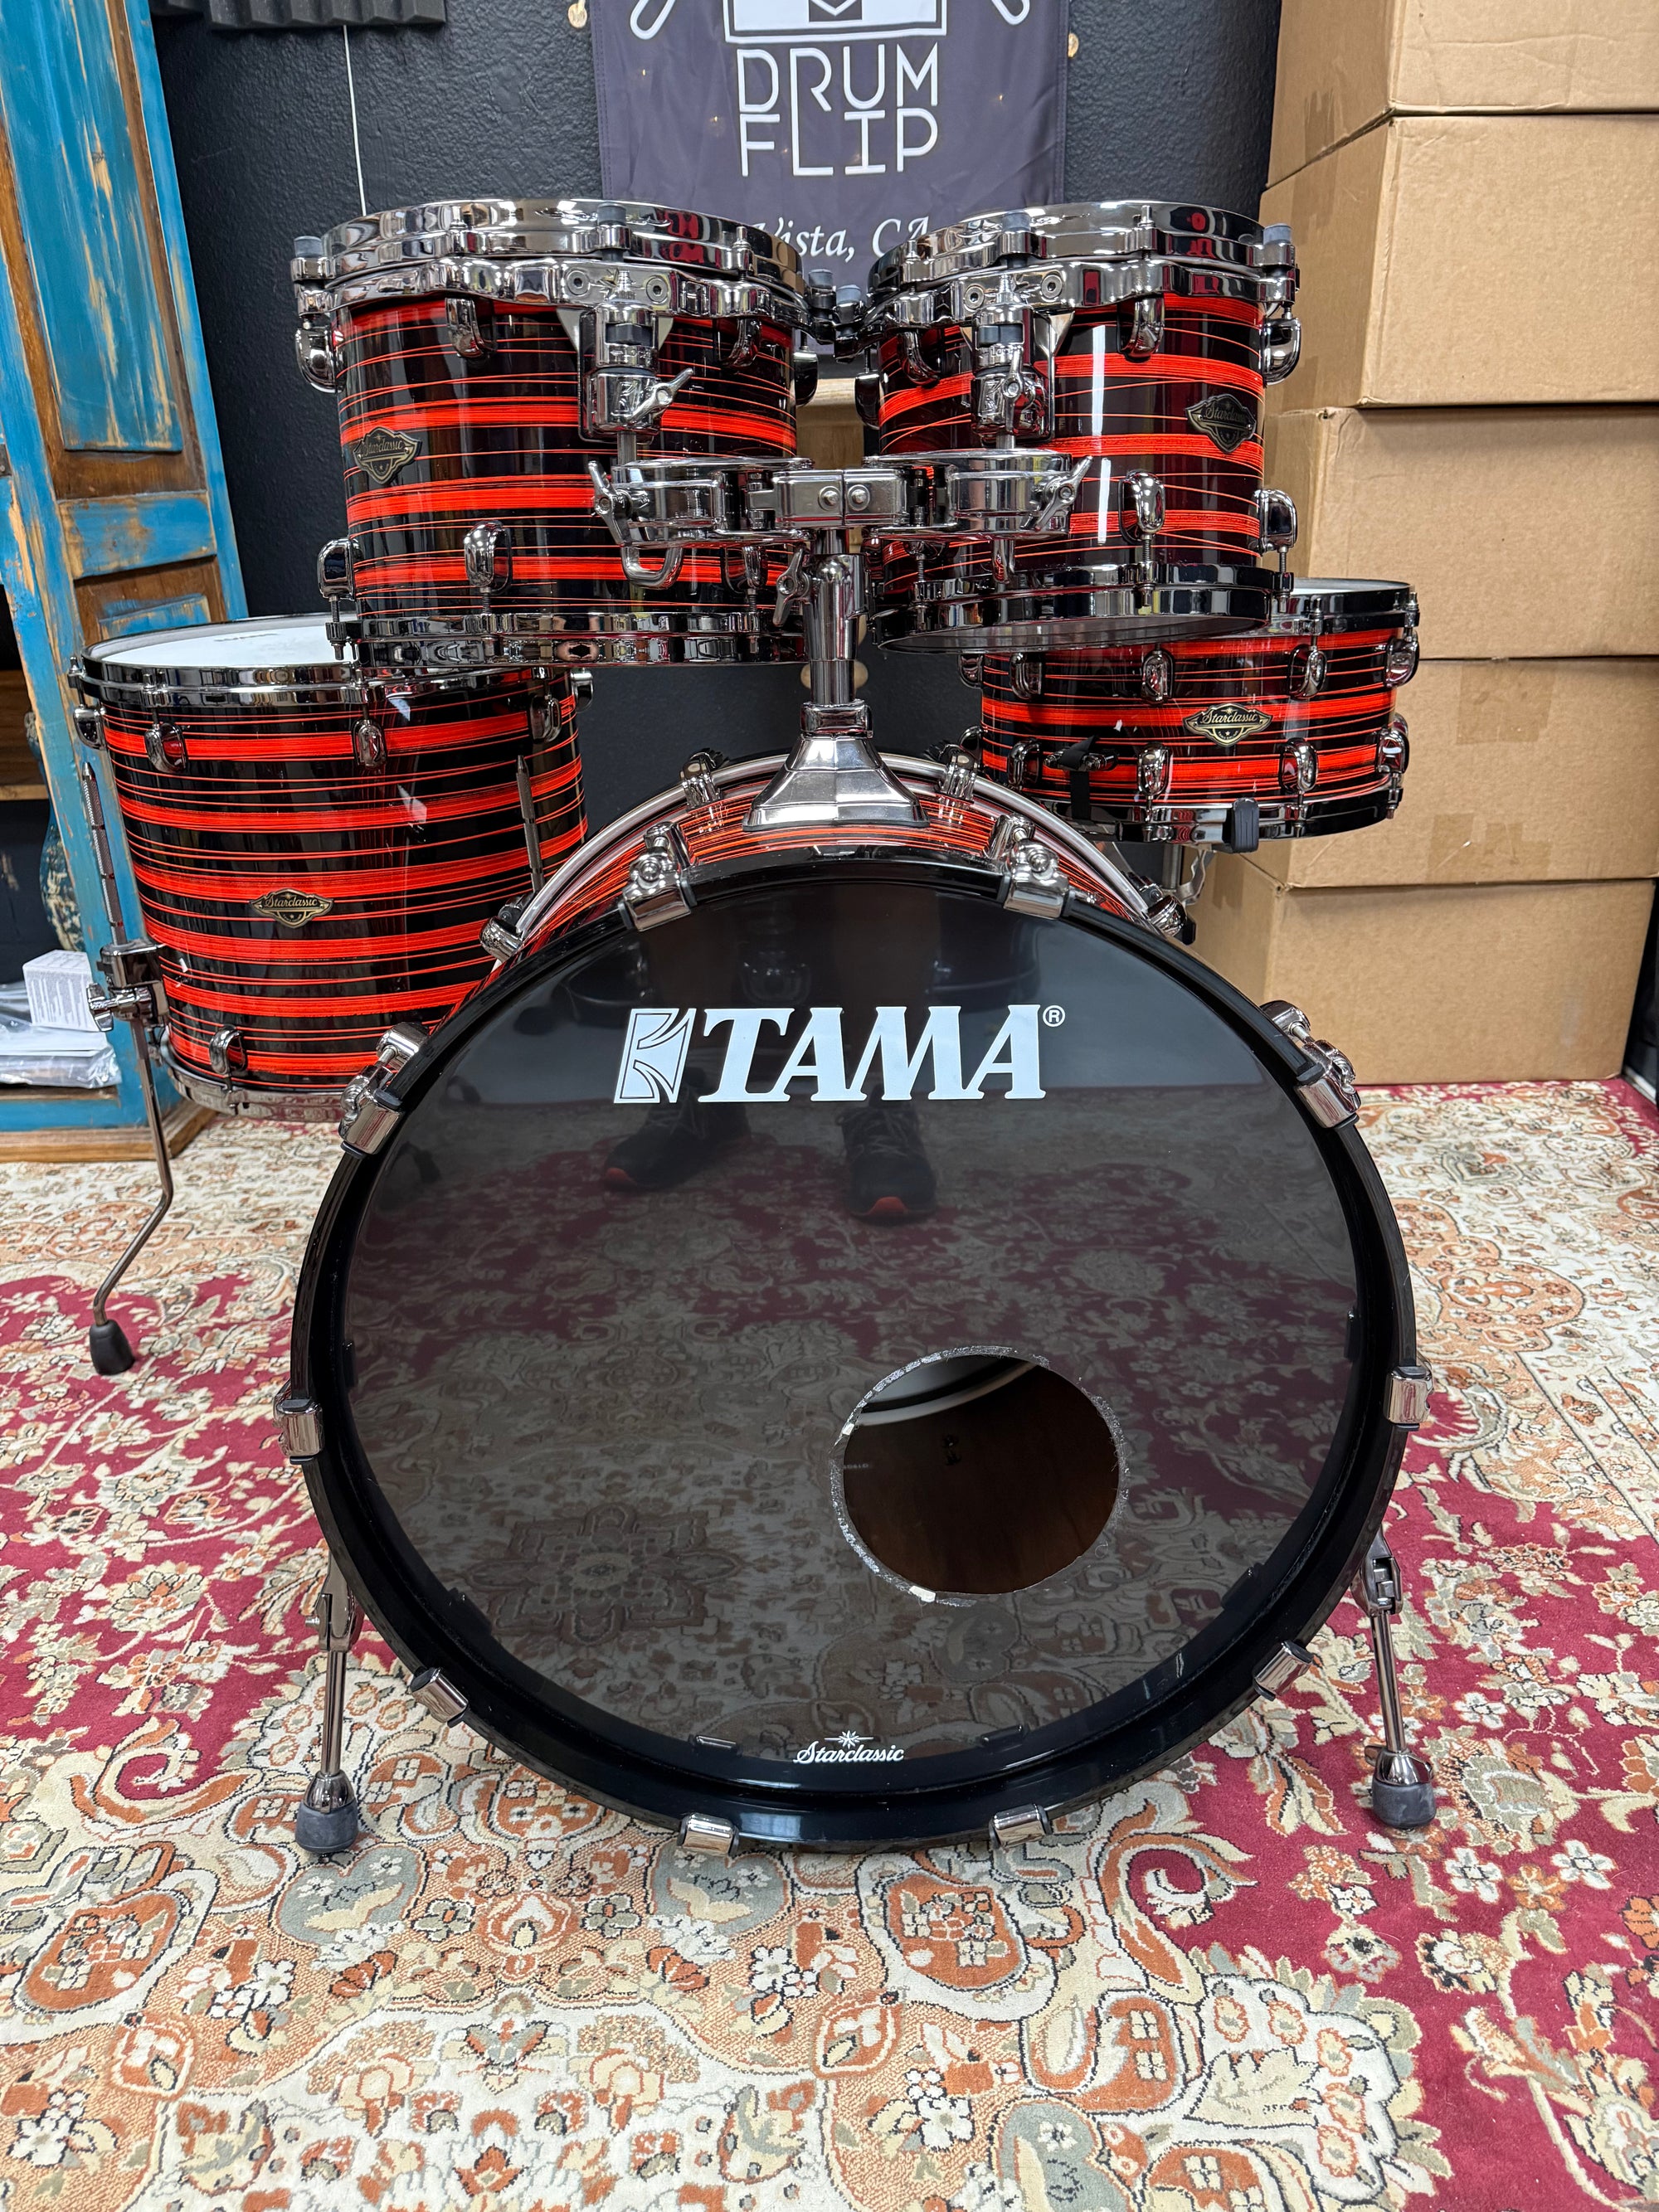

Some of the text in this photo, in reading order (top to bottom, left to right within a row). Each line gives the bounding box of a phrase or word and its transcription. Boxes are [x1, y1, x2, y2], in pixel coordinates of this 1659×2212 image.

[737, 42, 939, 113] DRUM
[739, 108, 939, 177] FLIP
[1200, 711, 1258, 724] Starclassic
[265, 896, 318, 907] Starclassic
[793, 1740, 905, 1764] Starclassic
